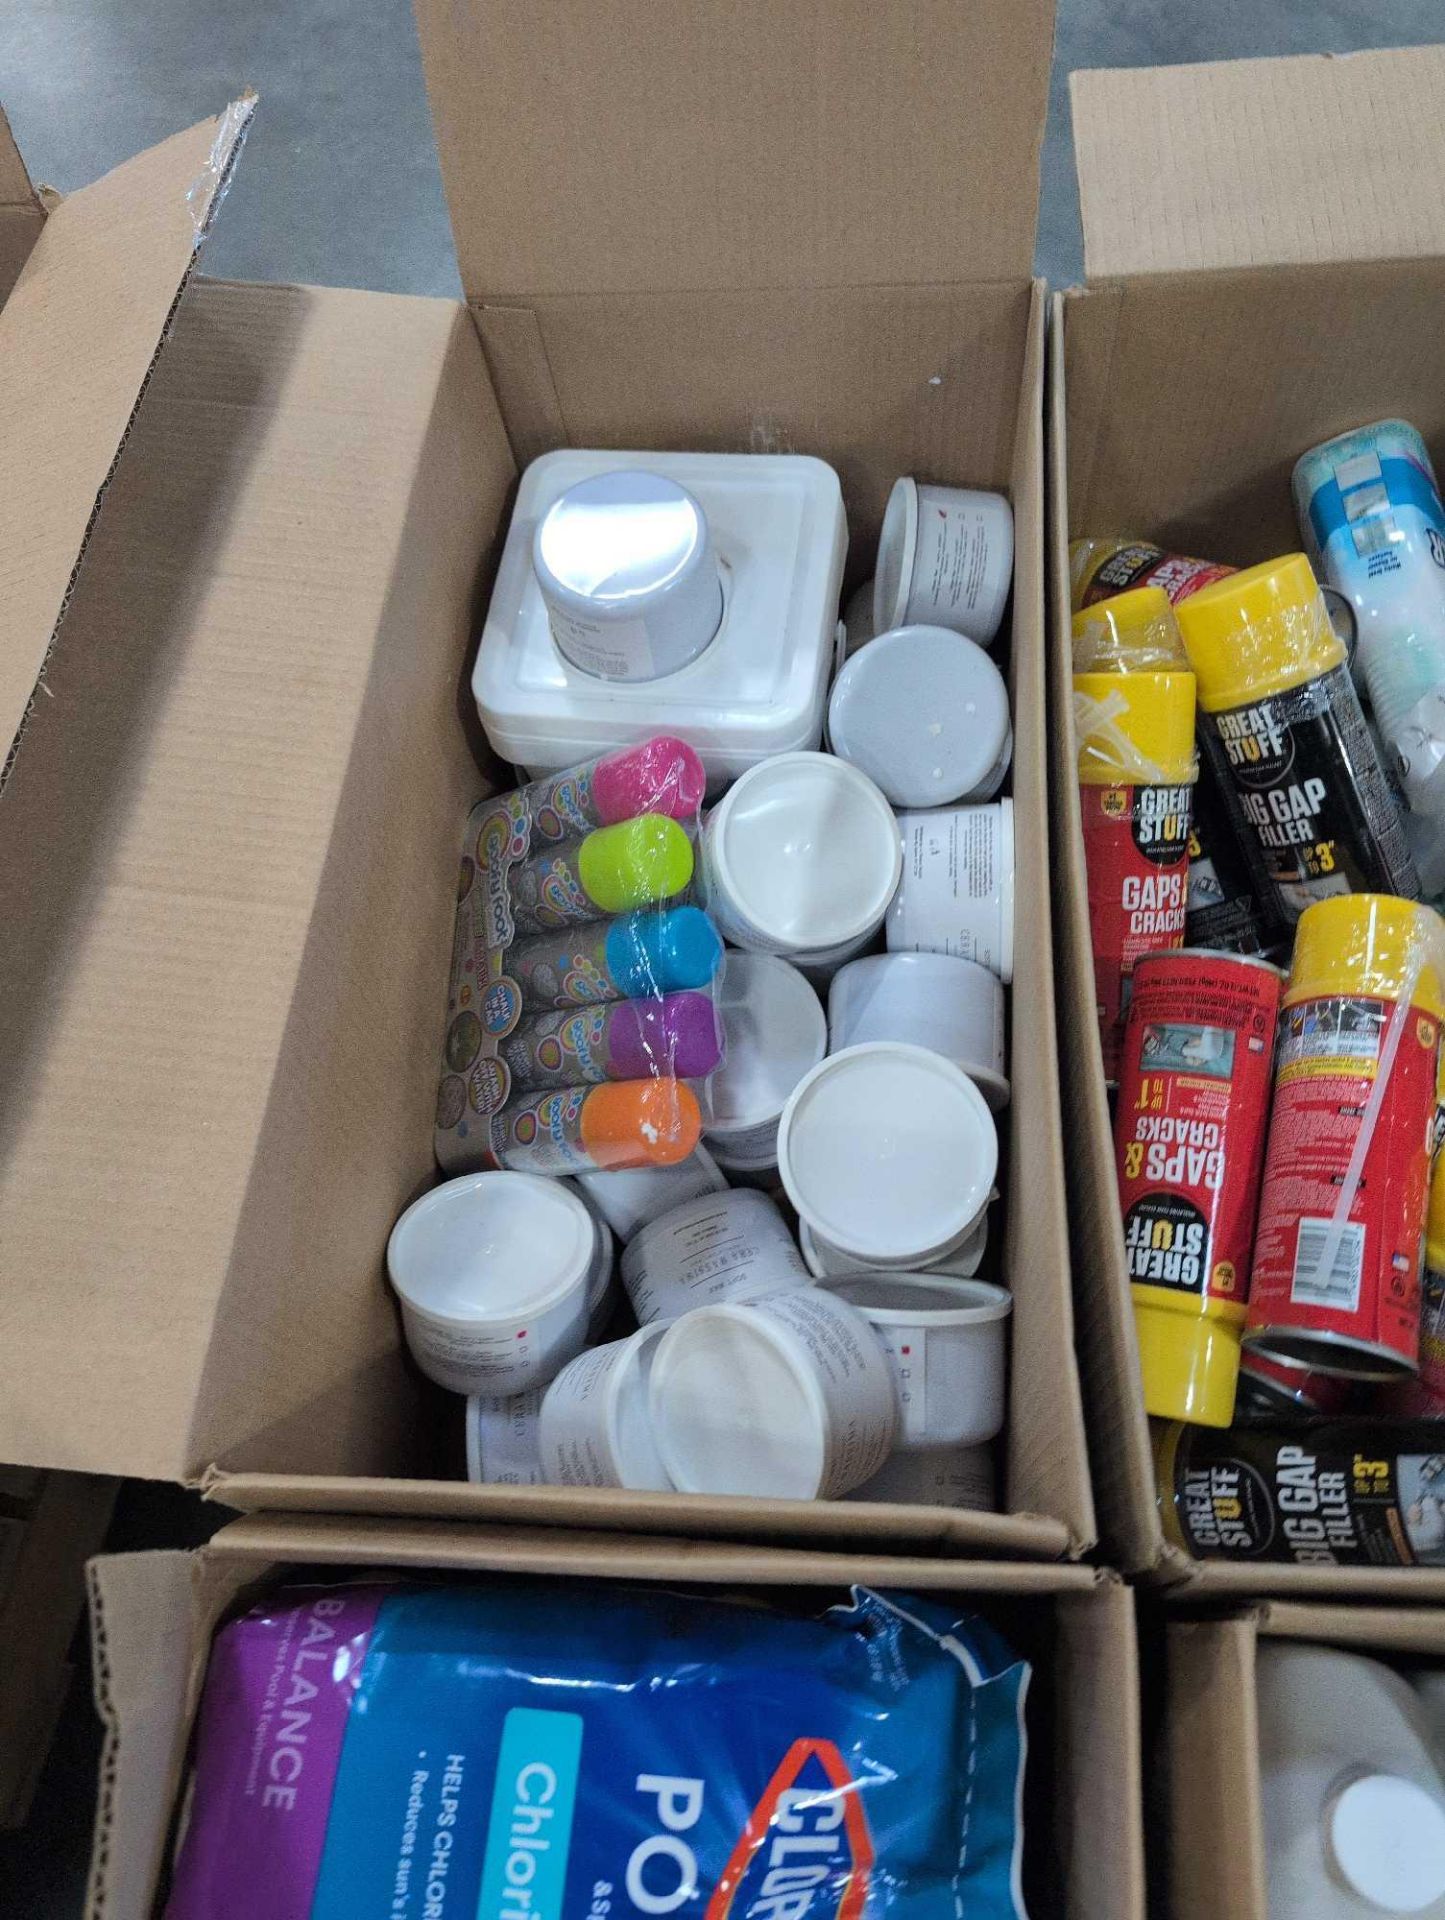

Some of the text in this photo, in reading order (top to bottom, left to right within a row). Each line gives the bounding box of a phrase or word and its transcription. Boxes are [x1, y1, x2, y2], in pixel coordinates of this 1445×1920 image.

[1216, 703, 1275, 740] GREAT
[1225, 727, 1284, 765] STUFF
[1141, 788, 1190, 816] GREAT
[1268, 778, 1326, 823] GAP
[1139, 815, 1188, 844] STUFF
[1258, 818, 1314, 847] FILLER
[1316, 840, 1335, 872] 3"
[1122, 874, 1181, 911] GAPS
[1130, 908, 1185, 934] CRACKS
[571, 1019, 592, 1070] goofy
[1134, 1078, 1149, 1109] 1"
[1151, 1094, 1162, 1110] UP
[1153, 1078, 1164, 1093] TO
[1135, 1115, 1219, 1149] CRACKS
[1124, 1142, 1225, 1189] GAPS &
[1127, 1215, 1204, 1254] STUFF
[1128, 1247, 1200, 1285] GREAT
[1353, 1454, 1389, 1478] 3"
[1185, 1467, 1221, 1547] GREAT
[1211, 1466, 1252, 1548] STUFF
[1276, 1445, 1338, 1566] BIG GAP
[1318, 1472, 1358, 1548] FILLER
[264, 1663, 285, 1697] Pool
[261, 1600, 345, 1811] BALANCE
[392, 1770, 429, 1909] Reduces sun's
[422, 1754, 465, 1920] HELPS CHLOR
[625, 1773, 705, 1915] PO
